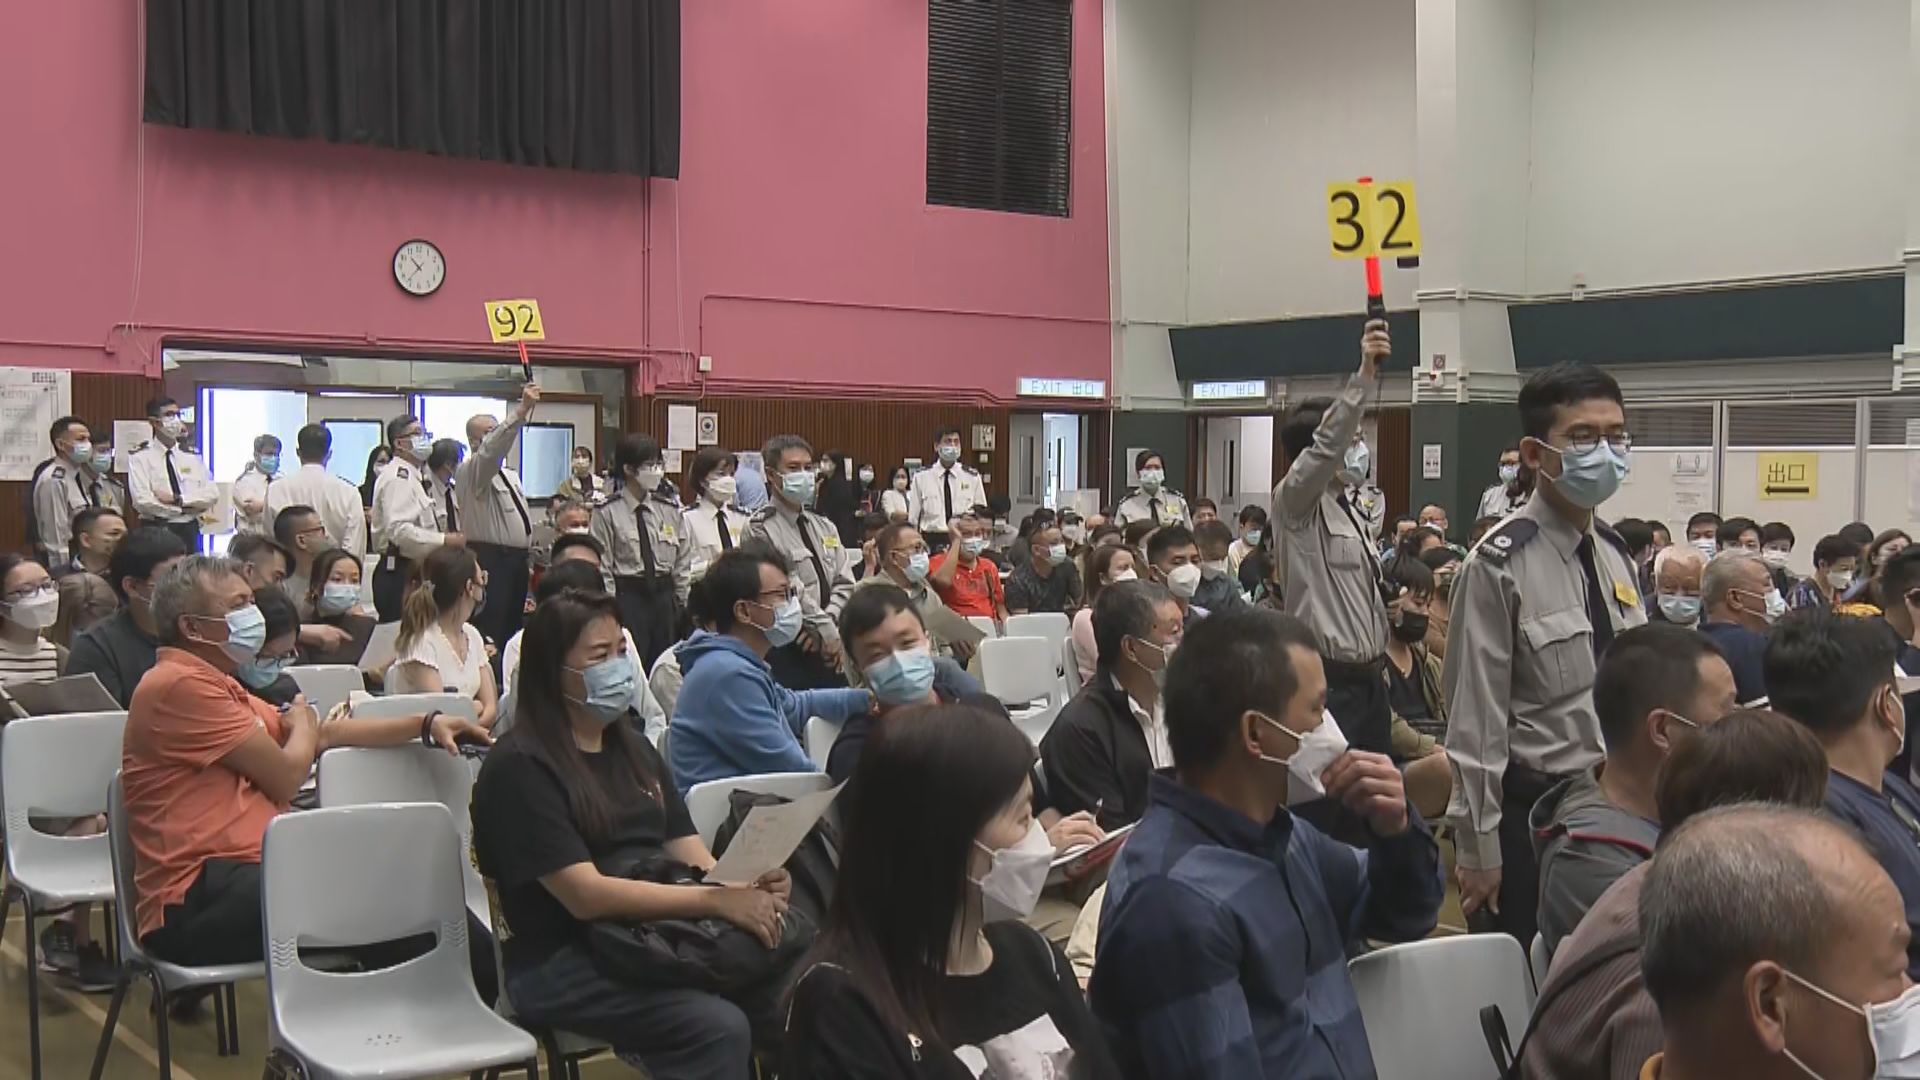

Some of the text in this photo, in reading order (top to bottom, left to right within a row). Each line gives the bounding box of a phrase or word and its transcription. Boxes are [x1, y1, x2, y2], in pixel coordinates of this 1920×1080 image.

[1330, 188, 1413, 253] 32
[494, 304, 539, 337] 92
[1031, 380, 1062, 393] EXIT
[1201, 383, 1228, 397] EXIT
[1767, 461, 1806, 483] 出口
